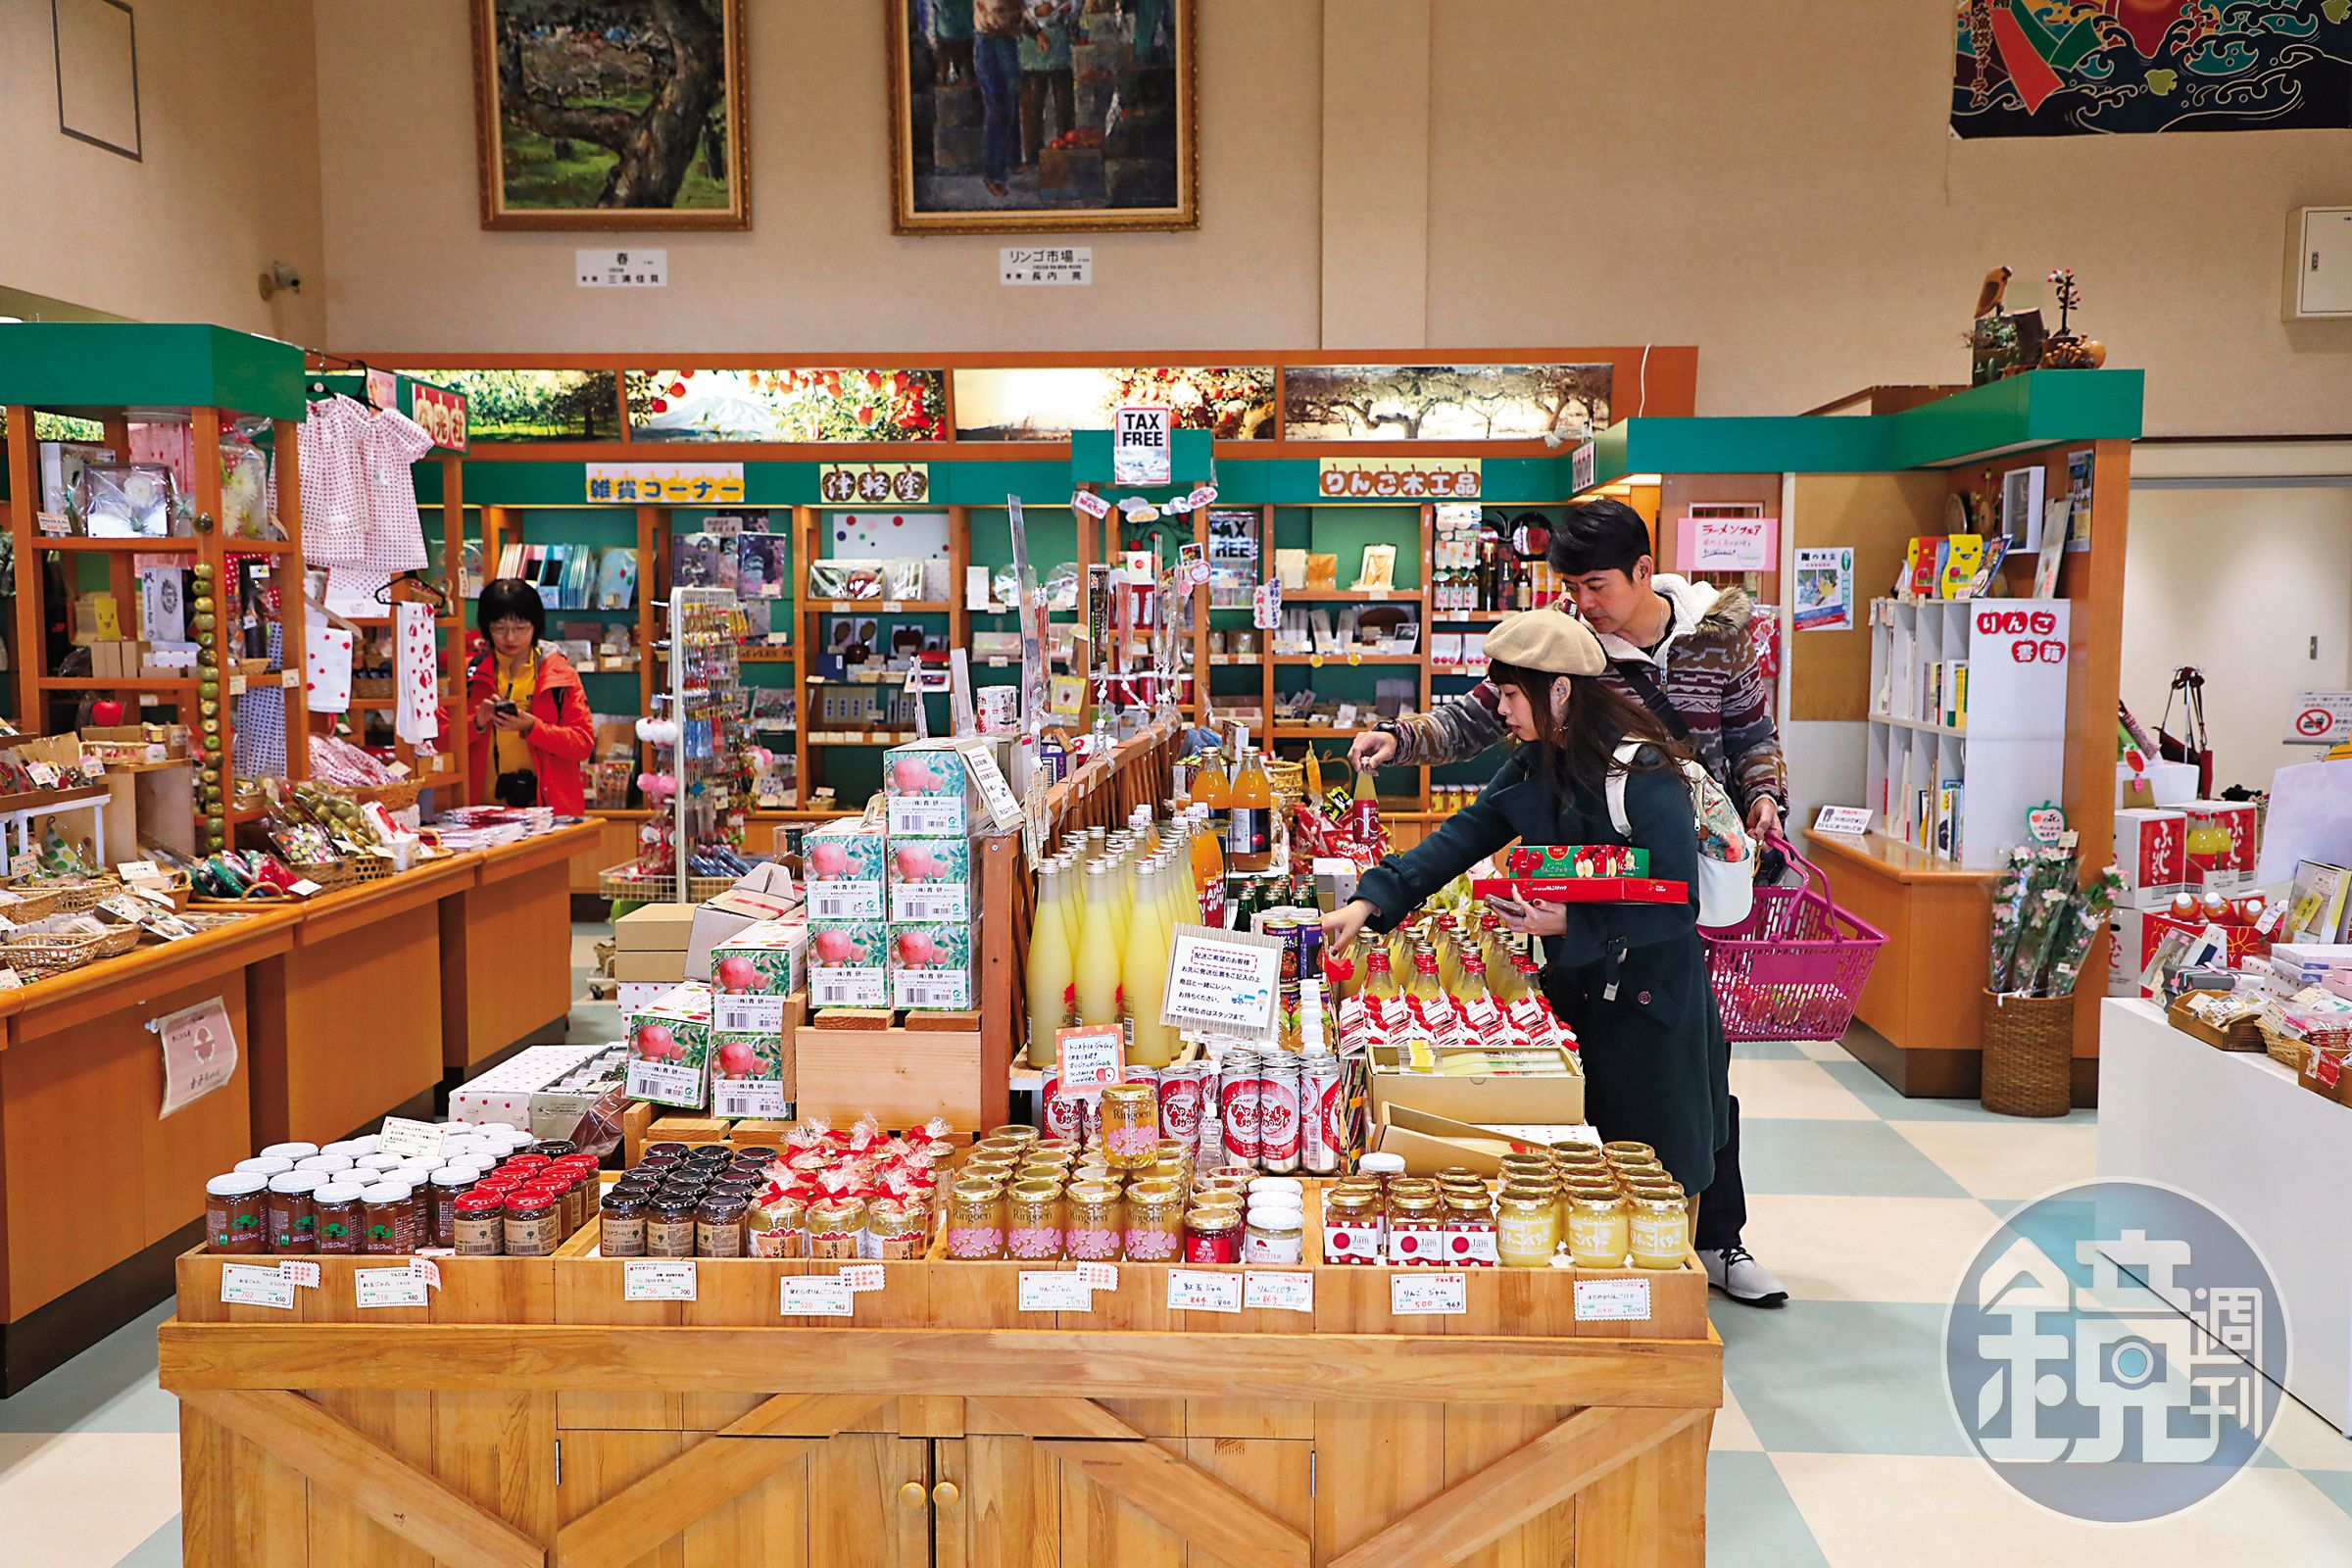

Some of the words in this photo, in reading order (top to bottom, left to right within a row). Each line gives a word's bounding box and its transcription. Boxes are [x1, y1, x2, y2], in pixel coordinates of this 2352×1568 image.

[1010, 250, 1074, 264] リンゴ市場
[1124, 414, 1160, 430] TAX
[1122, 431, 1163, 447] FREE
[590, 478, 740, 500] 雑貨コーナー
[827, 471, 920, 500] 津軽塗
[1326, 472, 1477, 496] りんご木工品
[1194, 952, 1250, 966] 配送ご希望のお客様
[1181, 965, 1261, 983] お先に発送伝票をご記入の上
[1179, 978, 1233, 992] 商品と一緒にレジへ
[1178, 991, 1220, 1004] お待ちください。
[1175, 1004, 1247, 1022] ご不明な点はスタッフまで。
[1113, 1109, 1152, 1122] Ringoen
[952, 1208, 992, 1225] Ringoen
[1012, 1208, 1053, 1225] Ringoen
[1069, 1209, 1108, 1226] Ringoen
[1127, 1210, 1164, 1226] Ringoen
[1351, 1235, 1370, 1245] Jam
[1419, 1238, 1438, 1248] Jam
[1470, 1239, 1489, 1249] Jam
